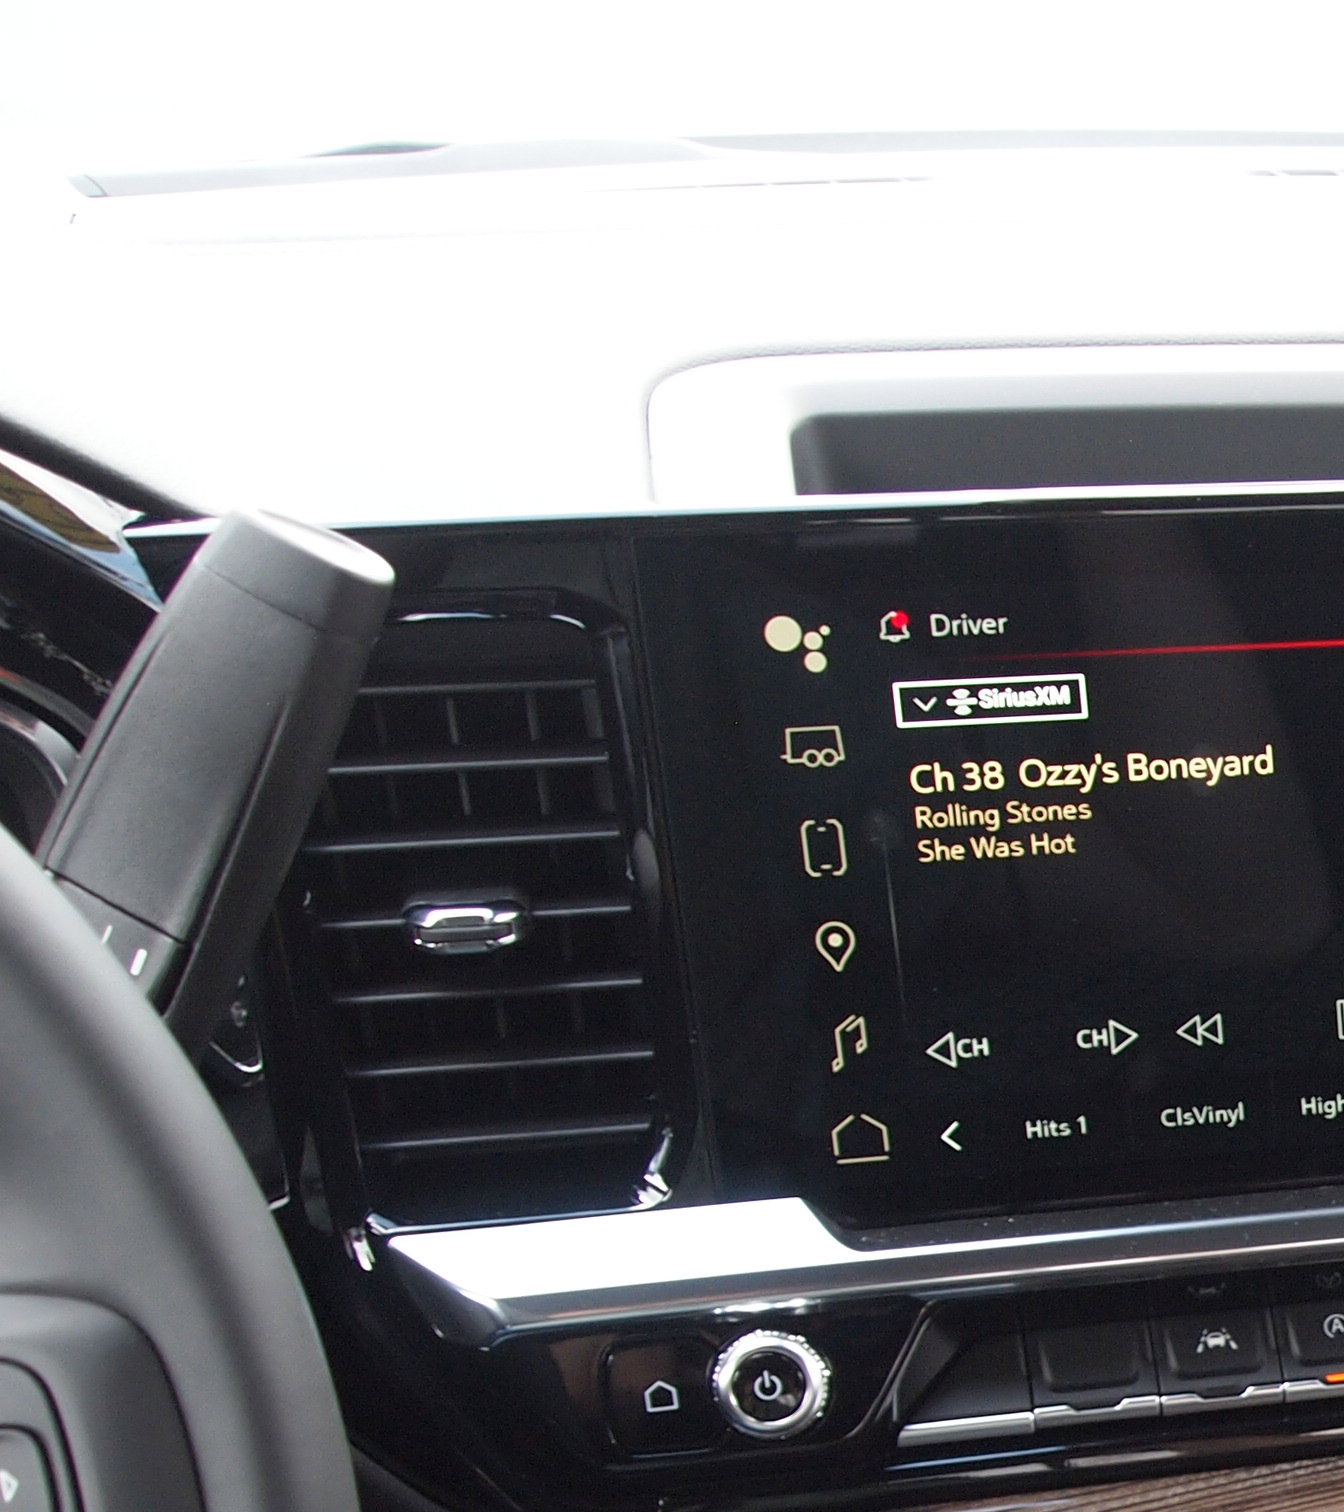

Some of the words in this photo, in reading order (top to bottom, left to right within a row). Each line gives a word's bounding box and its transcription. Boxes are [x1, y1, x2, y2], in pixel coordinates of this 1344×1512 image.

[929, 613, 1008, 637] Driver
[978, 684, 1072, 708] SiriusXM
[909, 762, 954, 793] Ch
[961, 760, 1005, 790] 38
[1018, 753, 1120, 793] Ozzy's
[1127, 744, 1275, 786] Boneyard
[914, 804, 1000, 831] Rolling
[1005, 800, 1092, 824] Stones
[917, 838, 965, 862] She
[970, 835, 1024, 859] Was
[1030, 833, 1076, 856] Hot
[956, 1037, 990, 1058] CH
[1076, 1027, 1108, 1049] CH
[1025, 1117, 1072, 1139] Hits
[1077, 1116, 1088, 1135] 1
[1160, 1102, 1246, 1129] ClsVinyl
